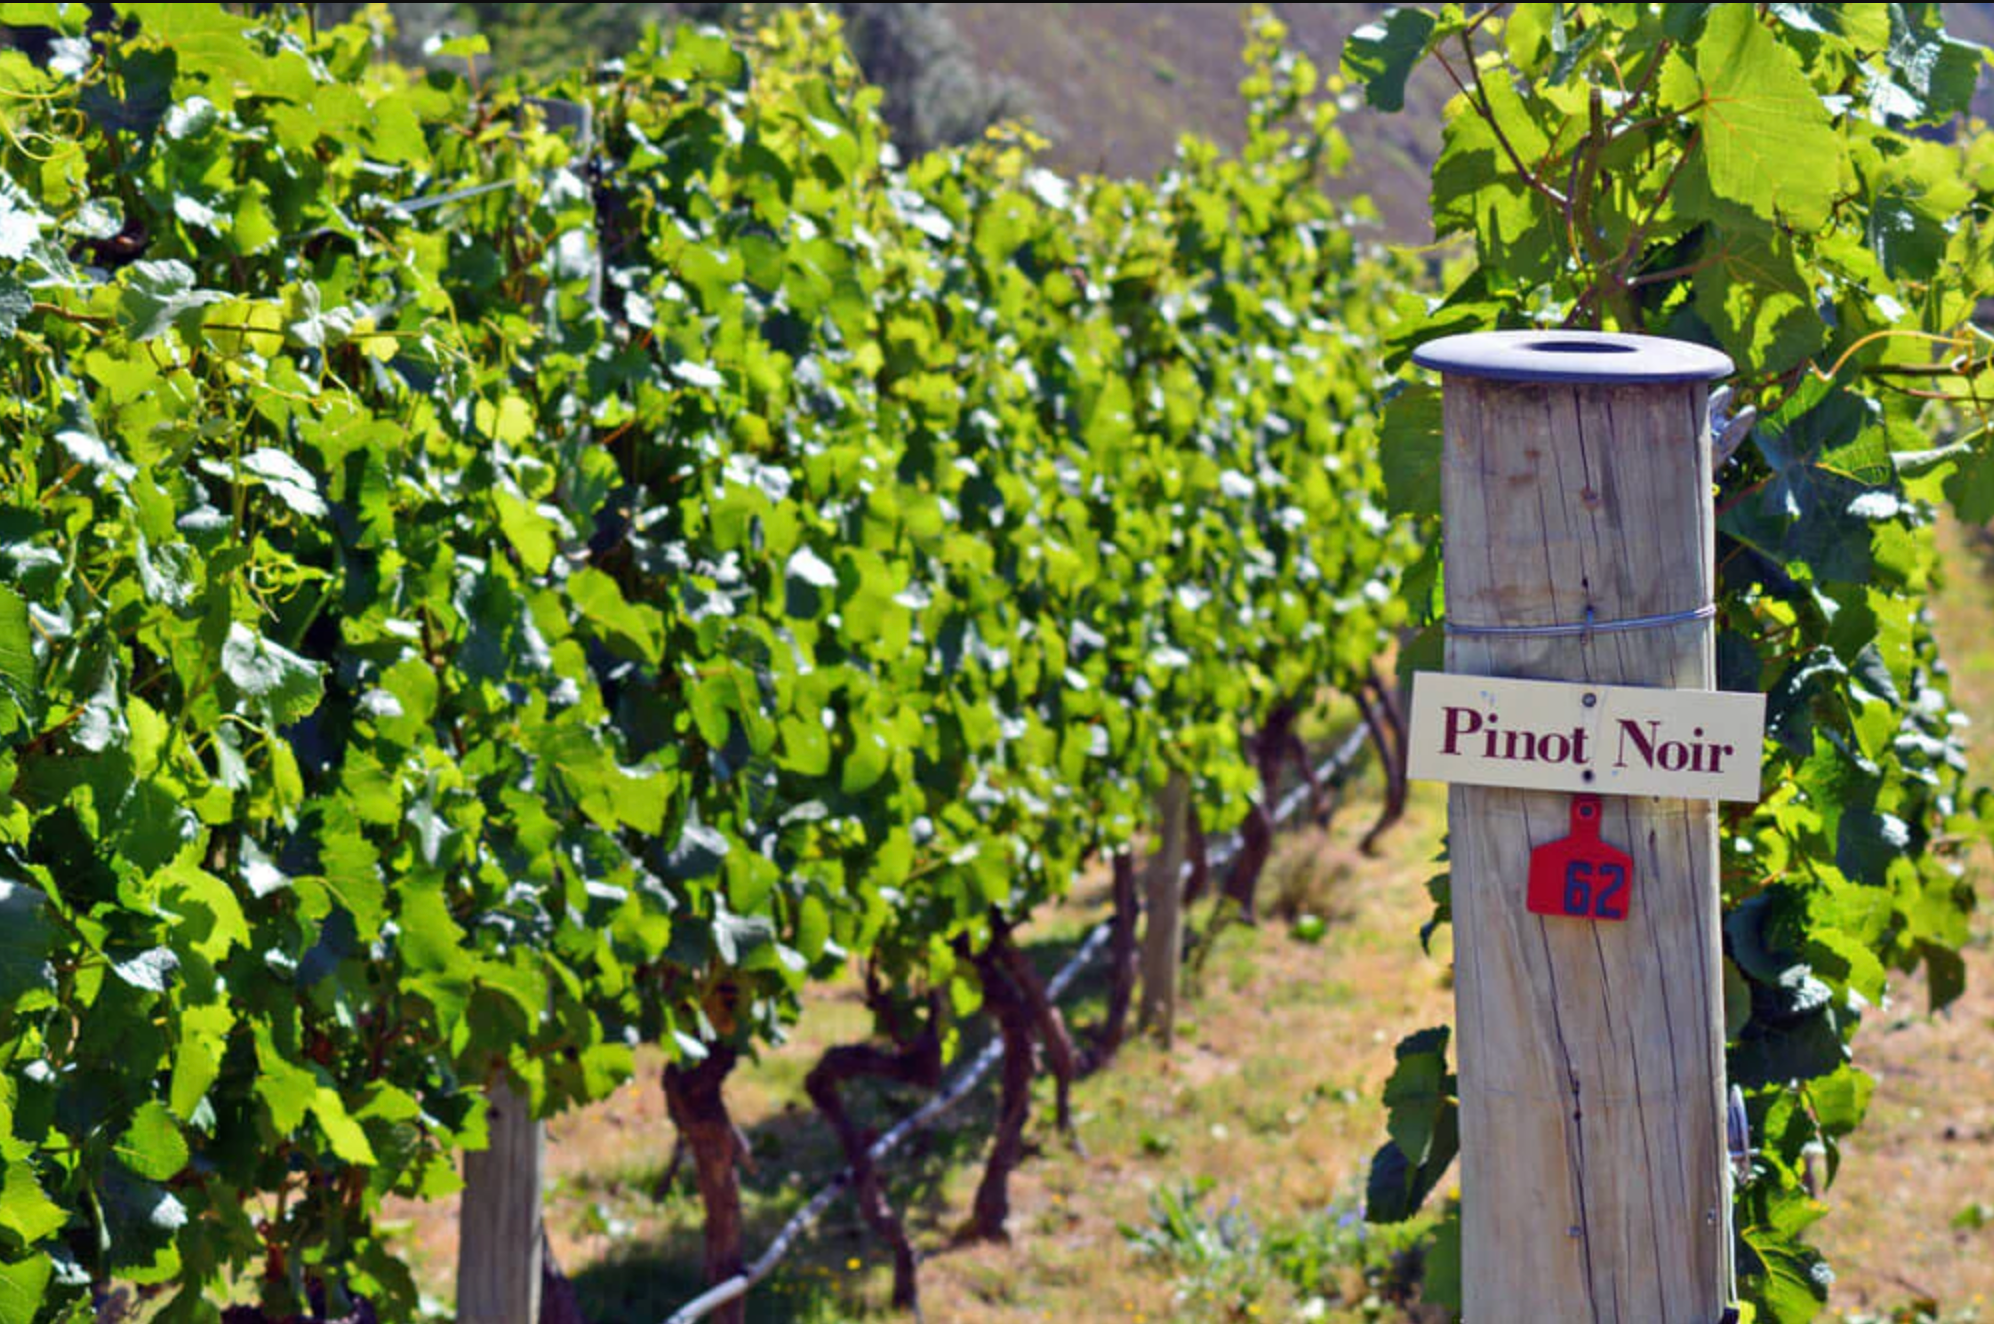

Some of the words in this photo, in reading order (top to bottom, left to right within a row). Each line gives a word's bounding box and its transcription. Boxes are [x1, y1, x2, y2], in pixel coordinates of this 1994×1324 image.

[1438, 706, 1590, 765] Pinot
[1612, 718, 1734, 773] Noir
[1563, 860, 1626, 919] 62
